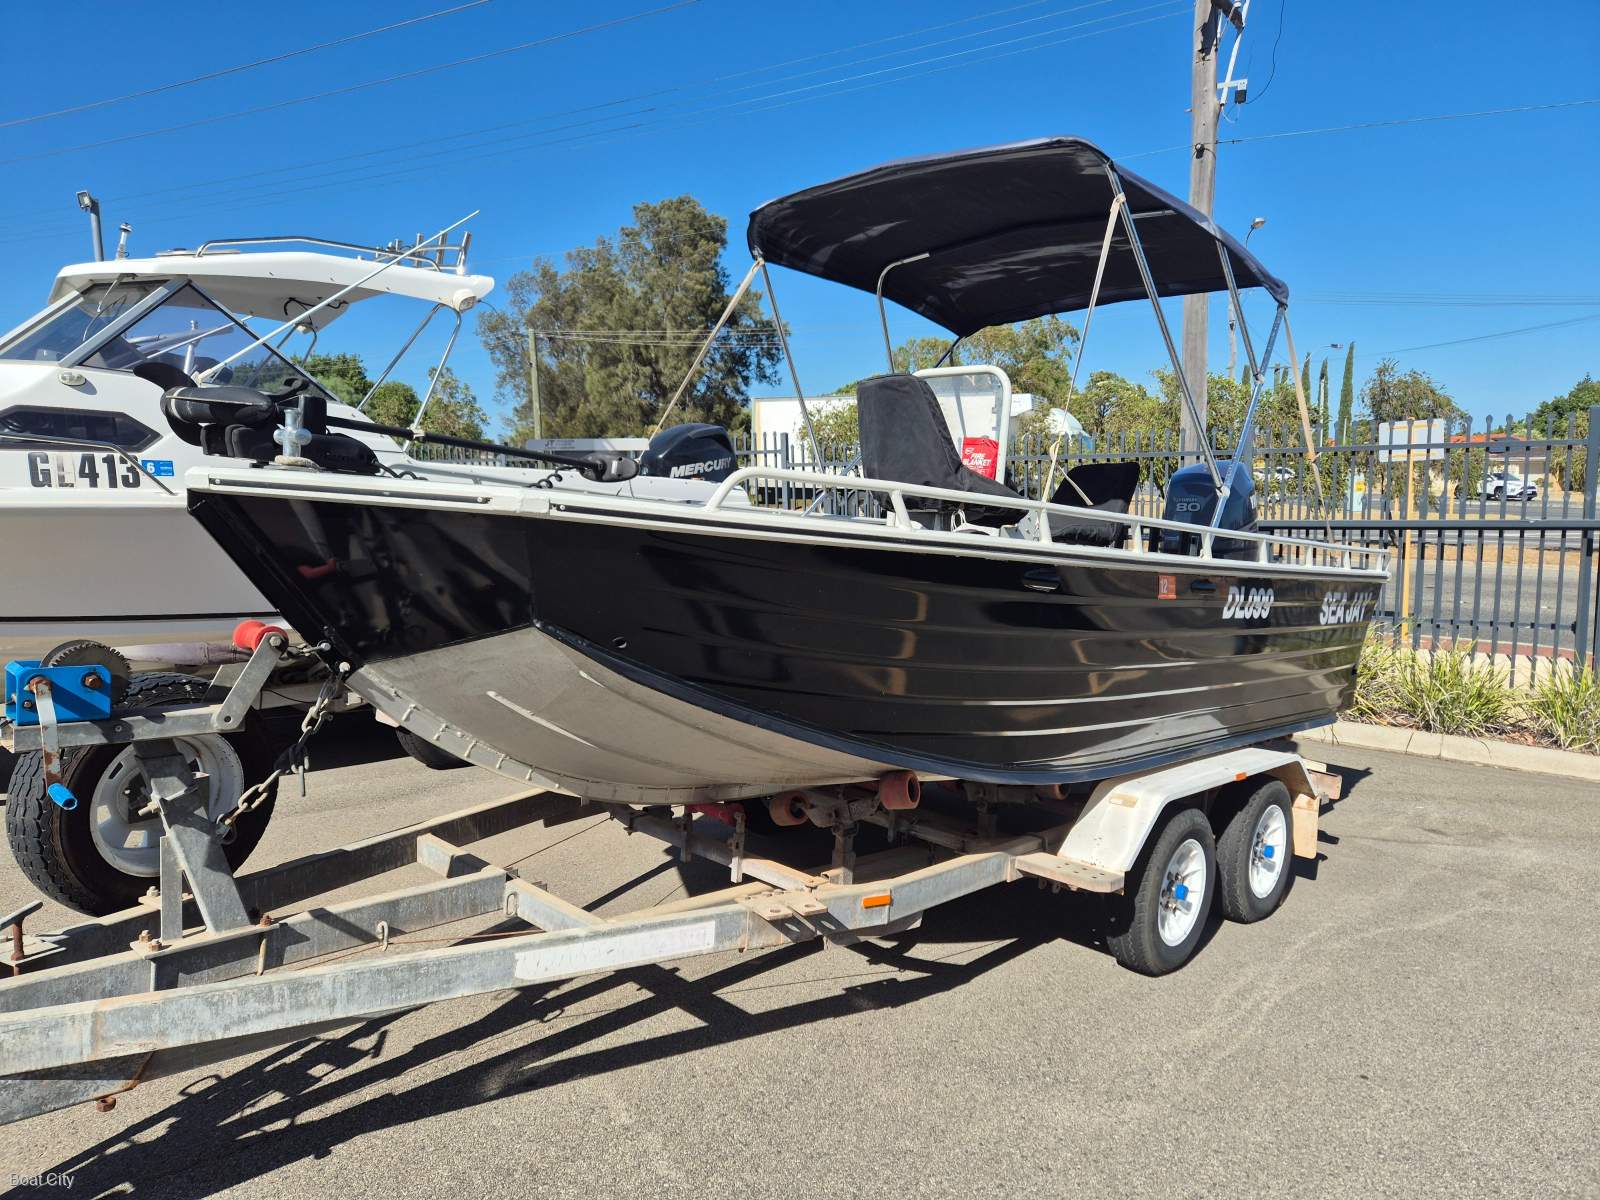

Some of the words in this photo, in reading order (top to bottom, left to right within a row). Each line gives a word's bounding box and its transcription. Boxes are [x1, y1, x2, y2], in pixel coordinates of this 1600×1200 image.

[146, 462, 156, 473] 6
[670, 457, 731, 478] MERCURY
[1176, 503, 1201, 511] 80
[1319, 591, 1348, 625] SEA
[1345, 592, 1374, 624] JAY
